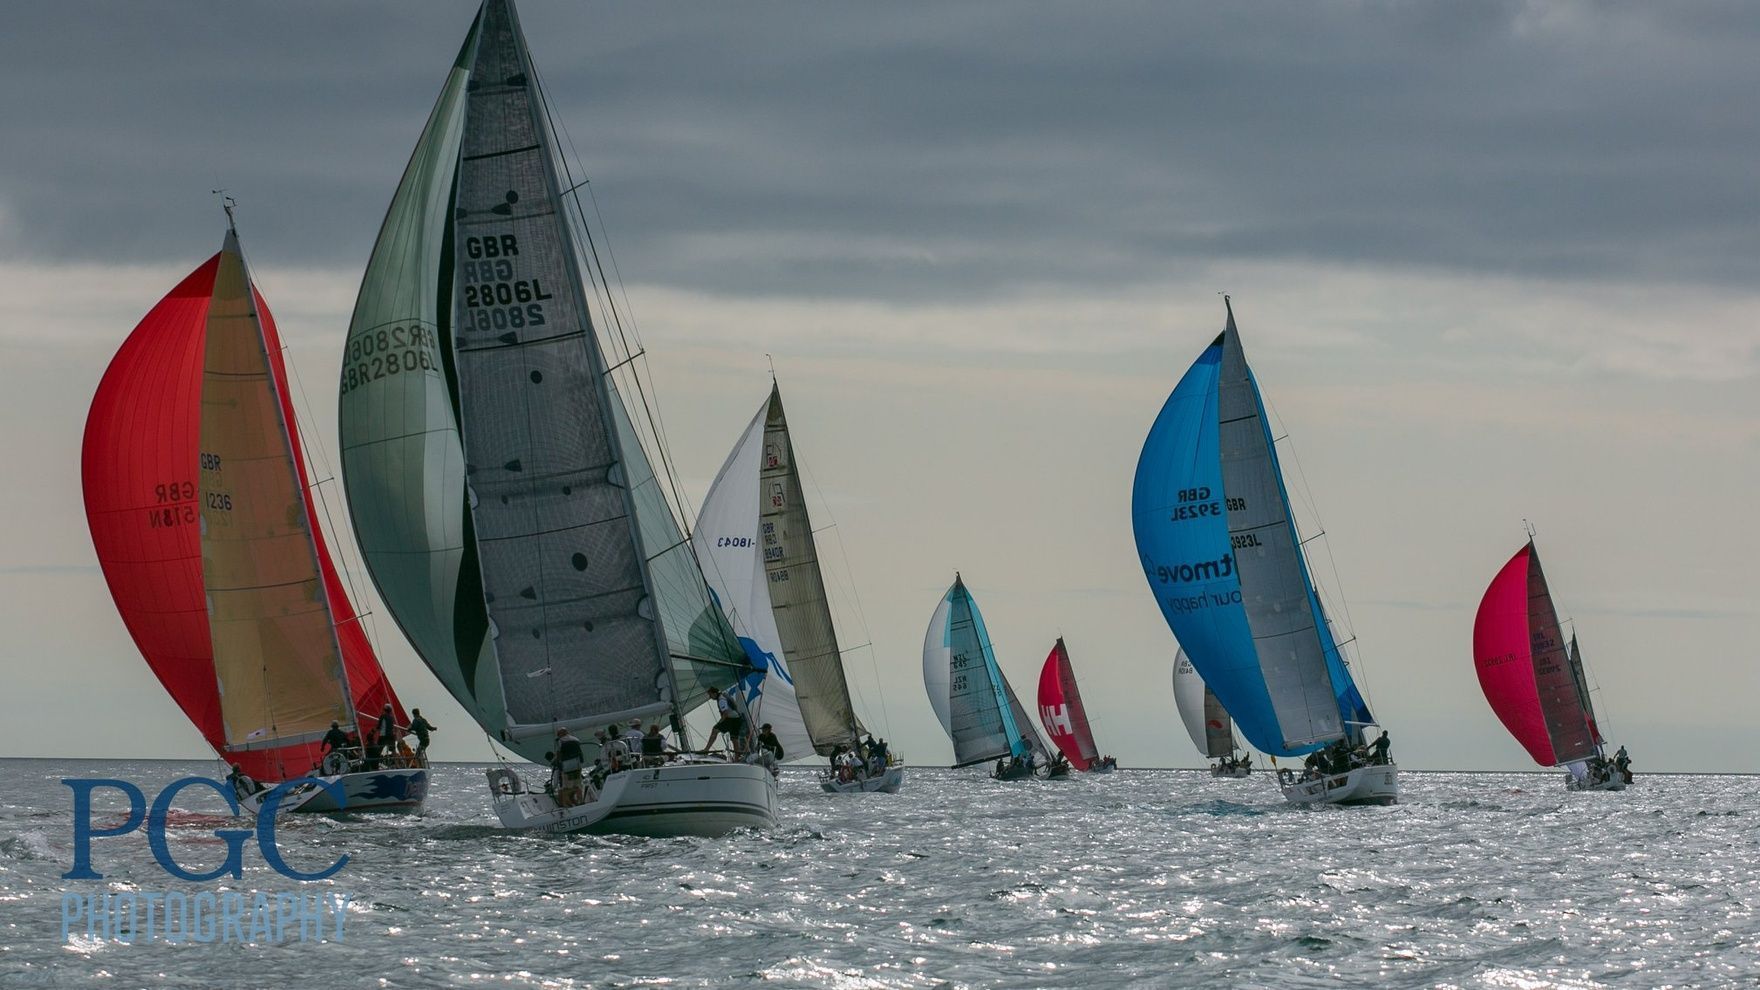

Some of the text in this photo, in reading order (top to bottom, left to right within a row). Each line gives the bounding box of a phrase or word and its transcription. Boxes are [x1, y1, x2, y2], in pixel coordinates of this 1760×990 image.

[466, 234, 519, 259] GBR
[465, 279, 553, 308] 2806L
[200, 452, 222, 471] GBR
[205, 491, 232, 511] 1236
[1226, 497, 1246, 511] GBR
